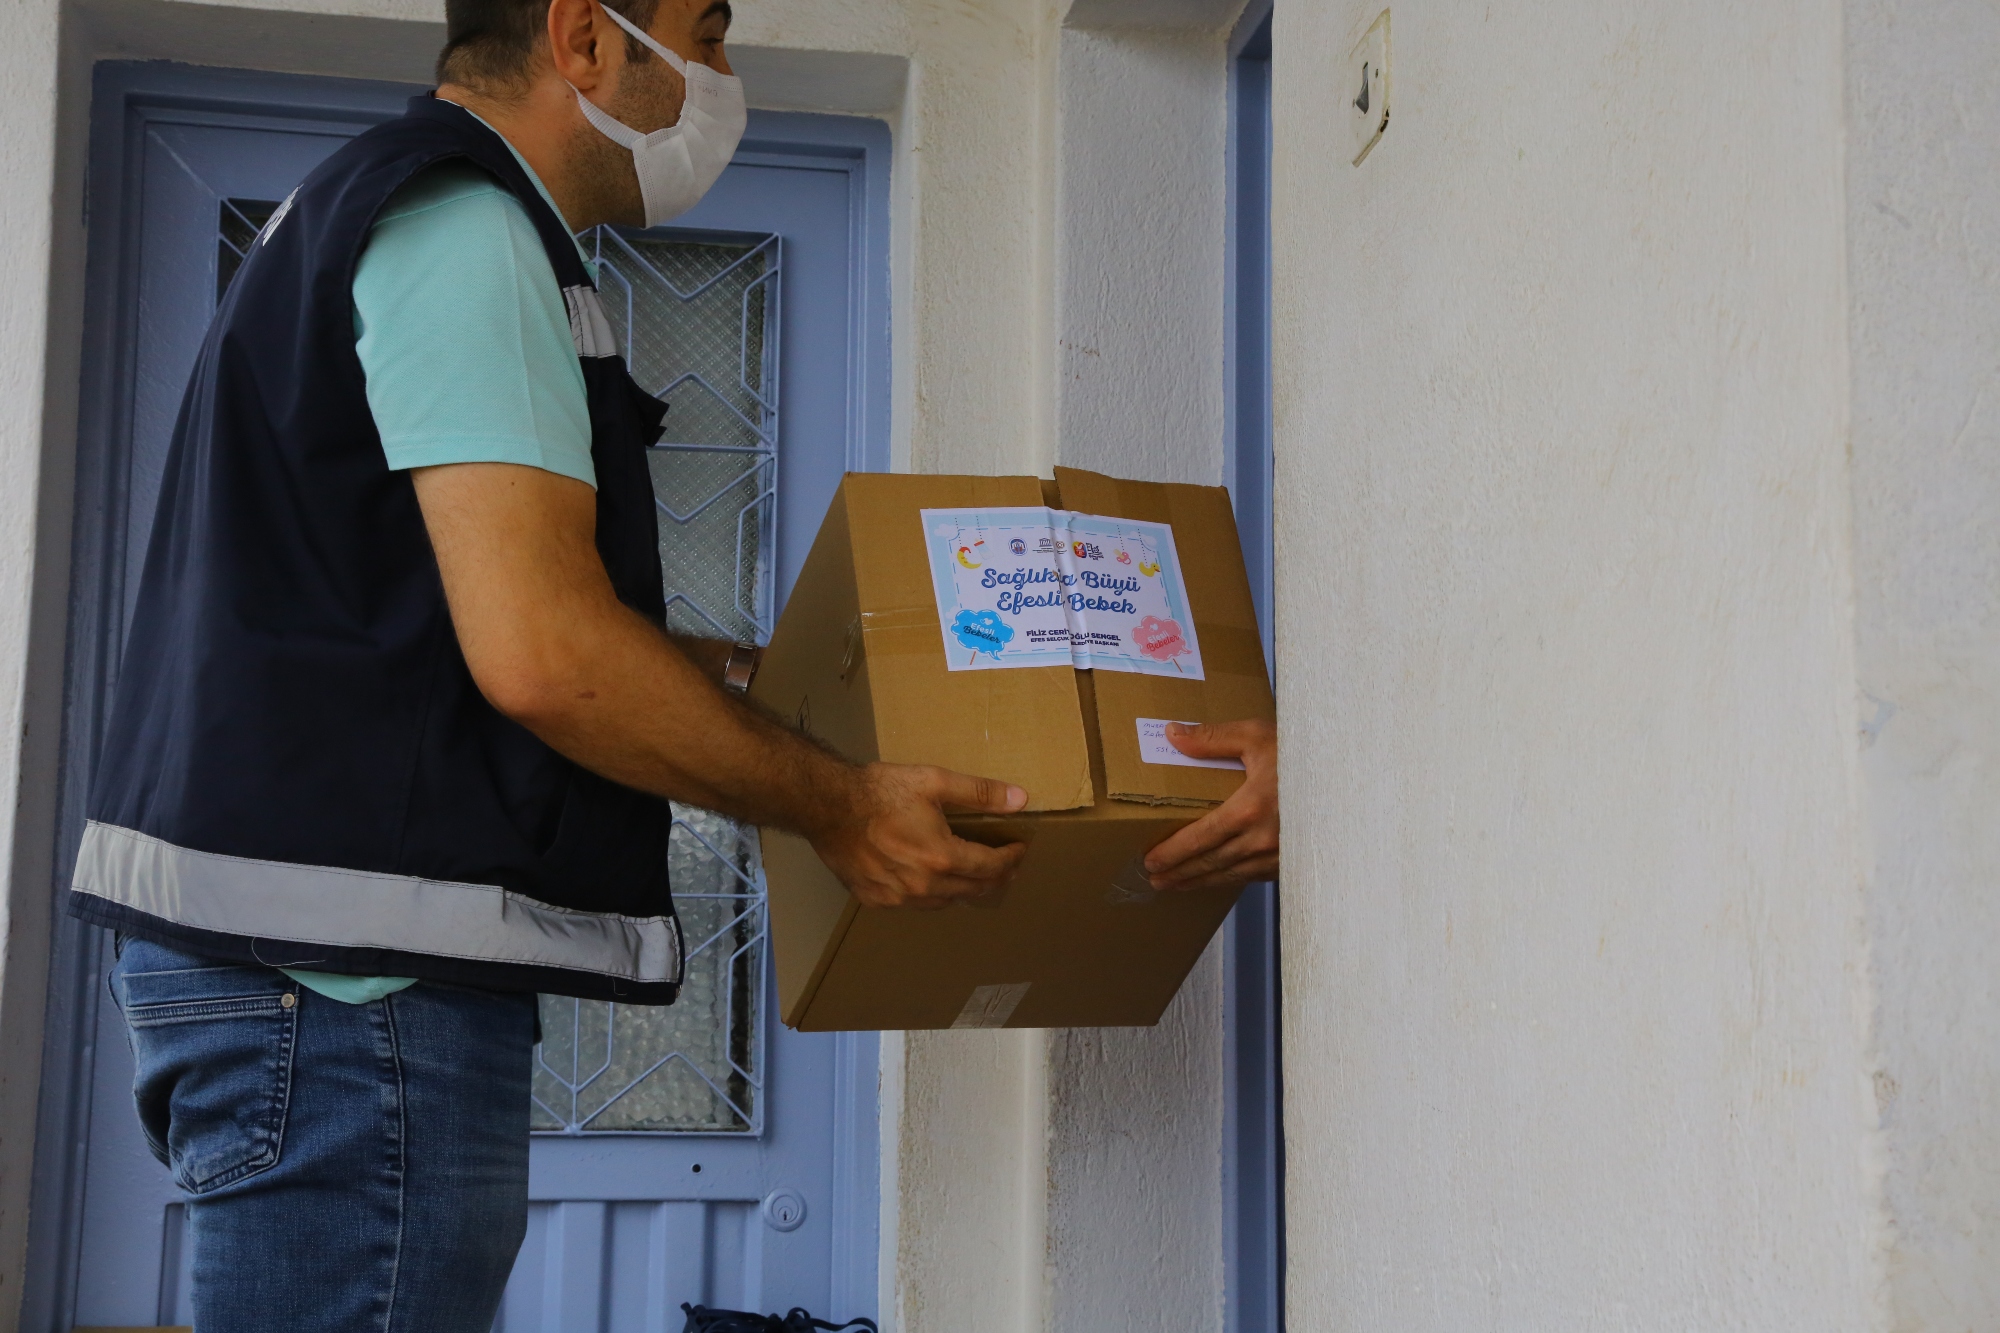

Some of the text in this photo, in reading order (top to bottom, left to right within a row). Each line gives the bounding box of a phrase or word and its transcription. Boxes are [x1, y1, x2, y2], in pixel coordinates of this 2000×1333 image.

[1081, 571, 1141, 596] Büyü
[997, 590, 1136, 615] Efesli Bebek
[963, 625, 1001, 643] Bebeler
[970, 622, 996, 636] Efesli
[1146, 634, 1180, 652] Bebeler
